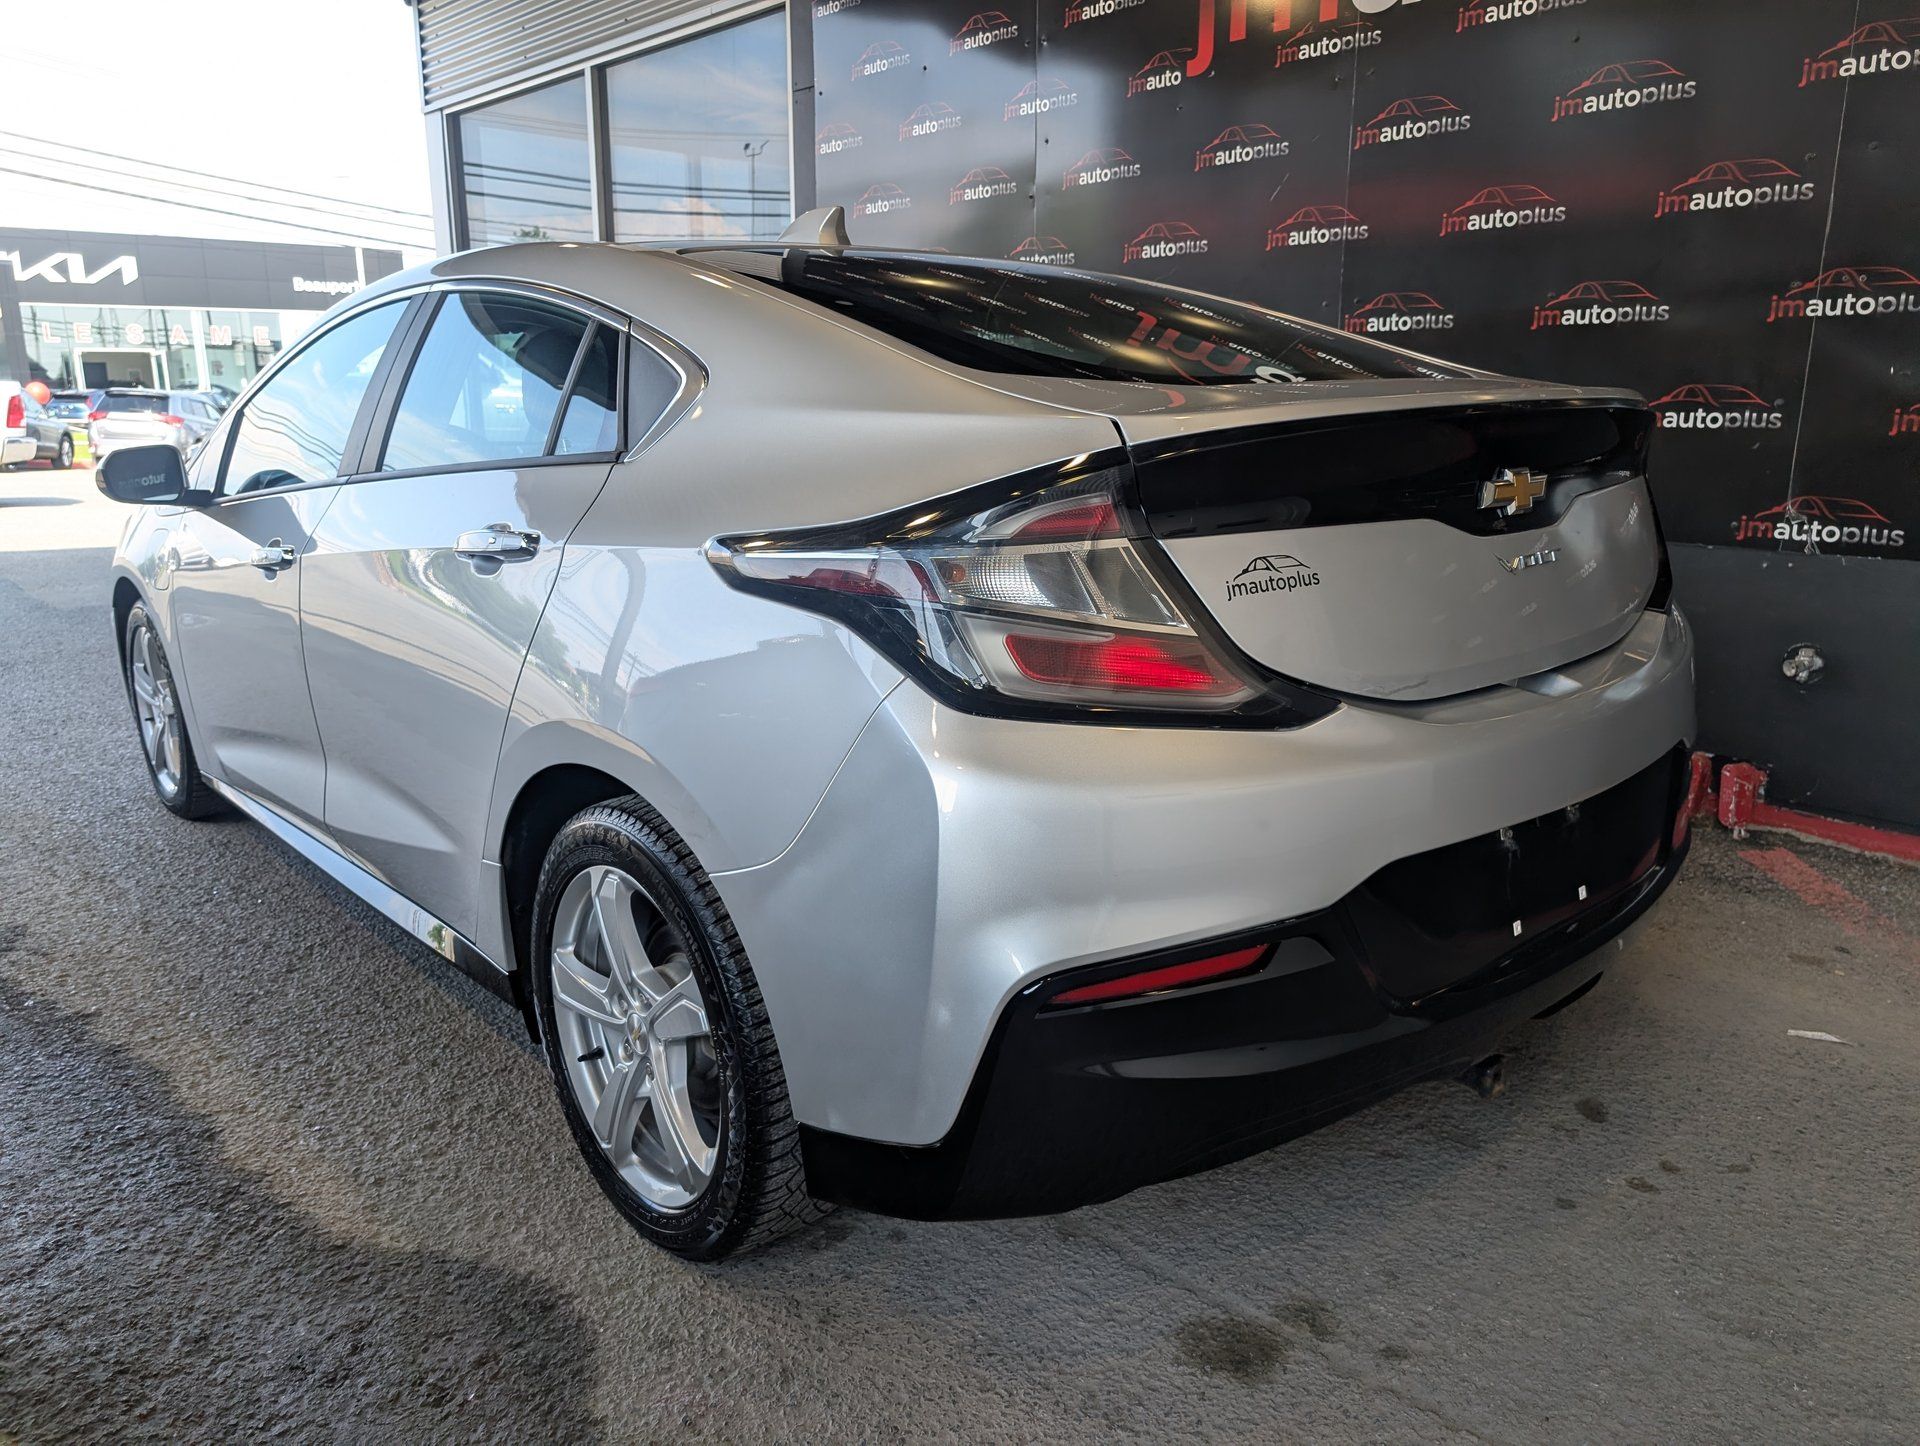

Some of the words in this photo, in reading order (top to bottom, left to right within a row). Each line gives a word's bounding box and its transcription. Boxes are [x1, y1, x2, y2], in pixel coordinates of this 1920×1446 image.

[950, 24, 1018, 57] jmautoplus
[1274, 28, 1383, 68] jmautoplus
[851, 54, 911, 82] jmautoplus
[1126, 69, 1182, 98] jmauto
[1003, 91, 1078, 122] jmautoplus
[1551, 79, 1696, 122] jmautoplus
[899, 115, 962, 142] jmautoplus
[1354, 112, 1471, 149] jmautoplus
[1195, 140, 1289, 171] jmautoplus
[1062, 163, 1141, 191] jmautoplus
[853, 195, 911, 218] jmautoplus
[950, 180, 1017, 206] jmautoplus
[1655, 180, 1814, 218] jmautoplus
[1440, 205, 1566, 237] jmautoplus
[1123, 238, 1208, 263] jmautoplus
[1265, 224, 1369, 251] jmautoplus
[1531, 302, 1670, 330] jmautoplus
[1736, 514, 1905, 547] jmautoplus
[1225, 569, 1320, 601] jmautoplus
